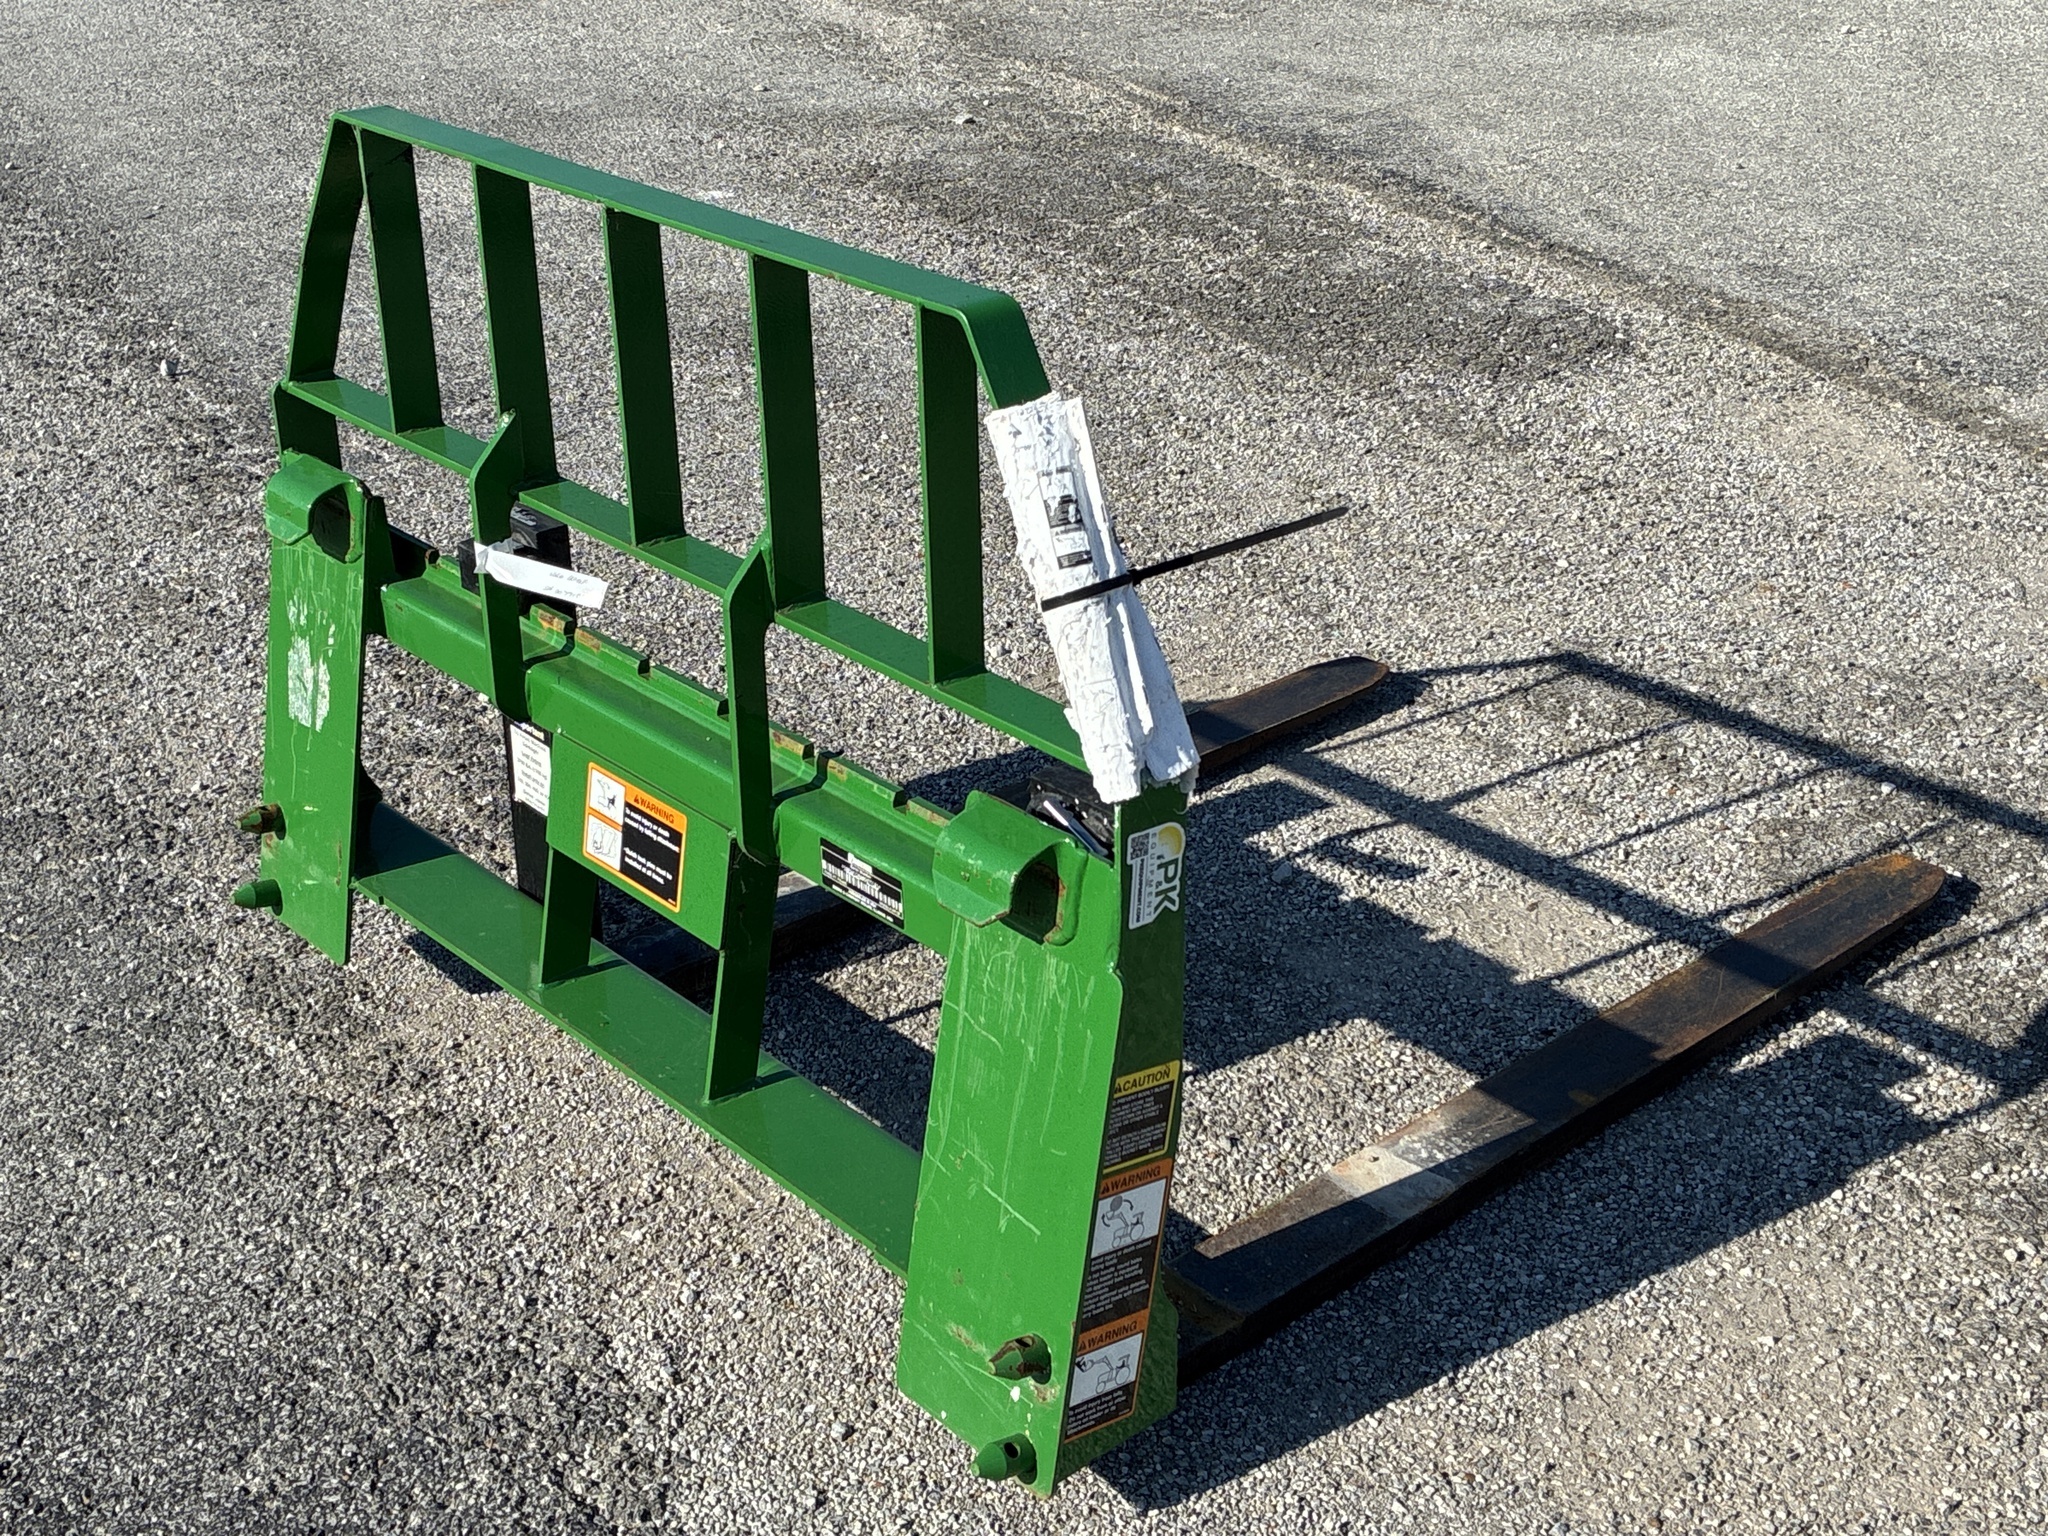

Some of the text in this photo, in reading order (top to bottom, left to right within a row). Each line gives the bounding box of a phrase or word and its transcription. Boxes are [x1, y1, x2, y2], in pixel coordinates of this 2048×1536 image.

[640, 796, 675, 825] WARNING
[1146, 832, 1157, 917] EQUIPMENT
[1122, 1068, 1171, 1092] CAUTION
[1110, 1165, 1161, 1192] WARNING
[1087, 1320, 1138, 1348] WARNING
